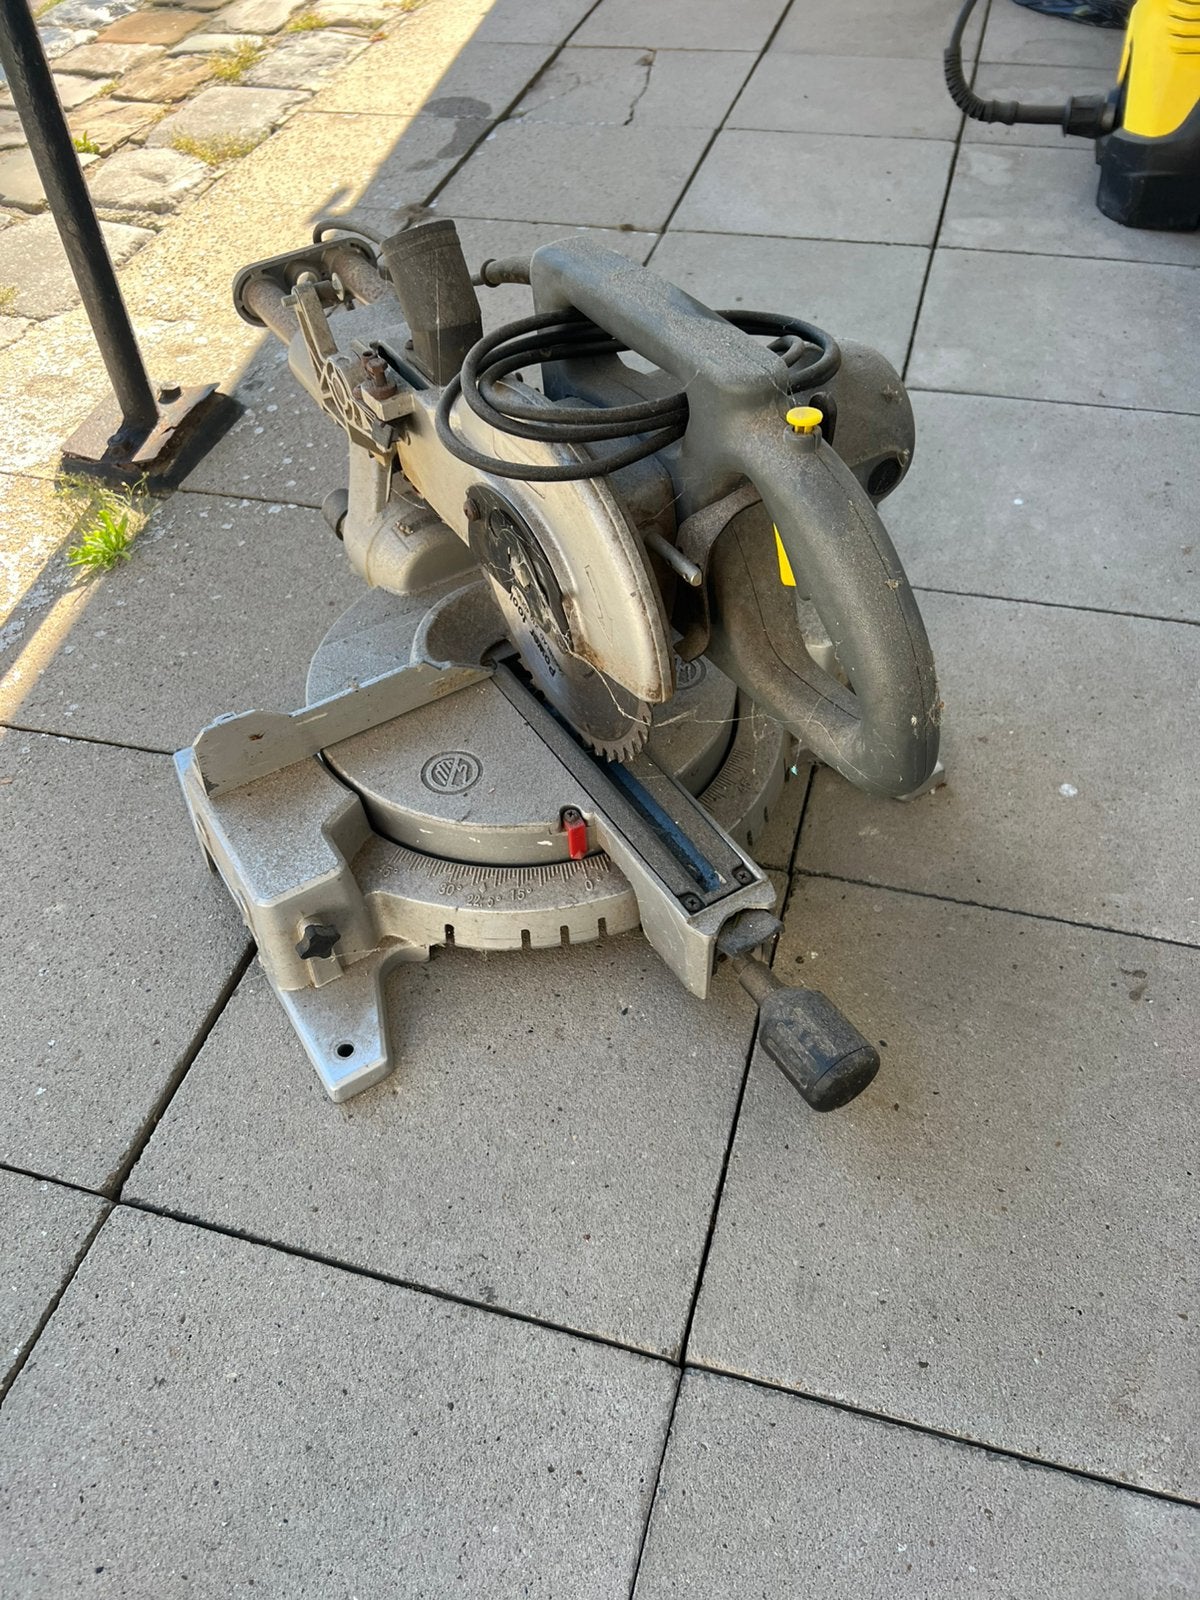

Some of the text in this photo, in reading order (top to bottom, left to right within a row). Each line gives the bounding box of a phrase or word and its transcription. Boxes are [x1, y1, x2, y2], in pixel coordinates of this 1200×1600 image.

[528, 628, 556, 677] Power
[438, 882, 463, 896] 30°
[509, 887, 533, 901] 15°
